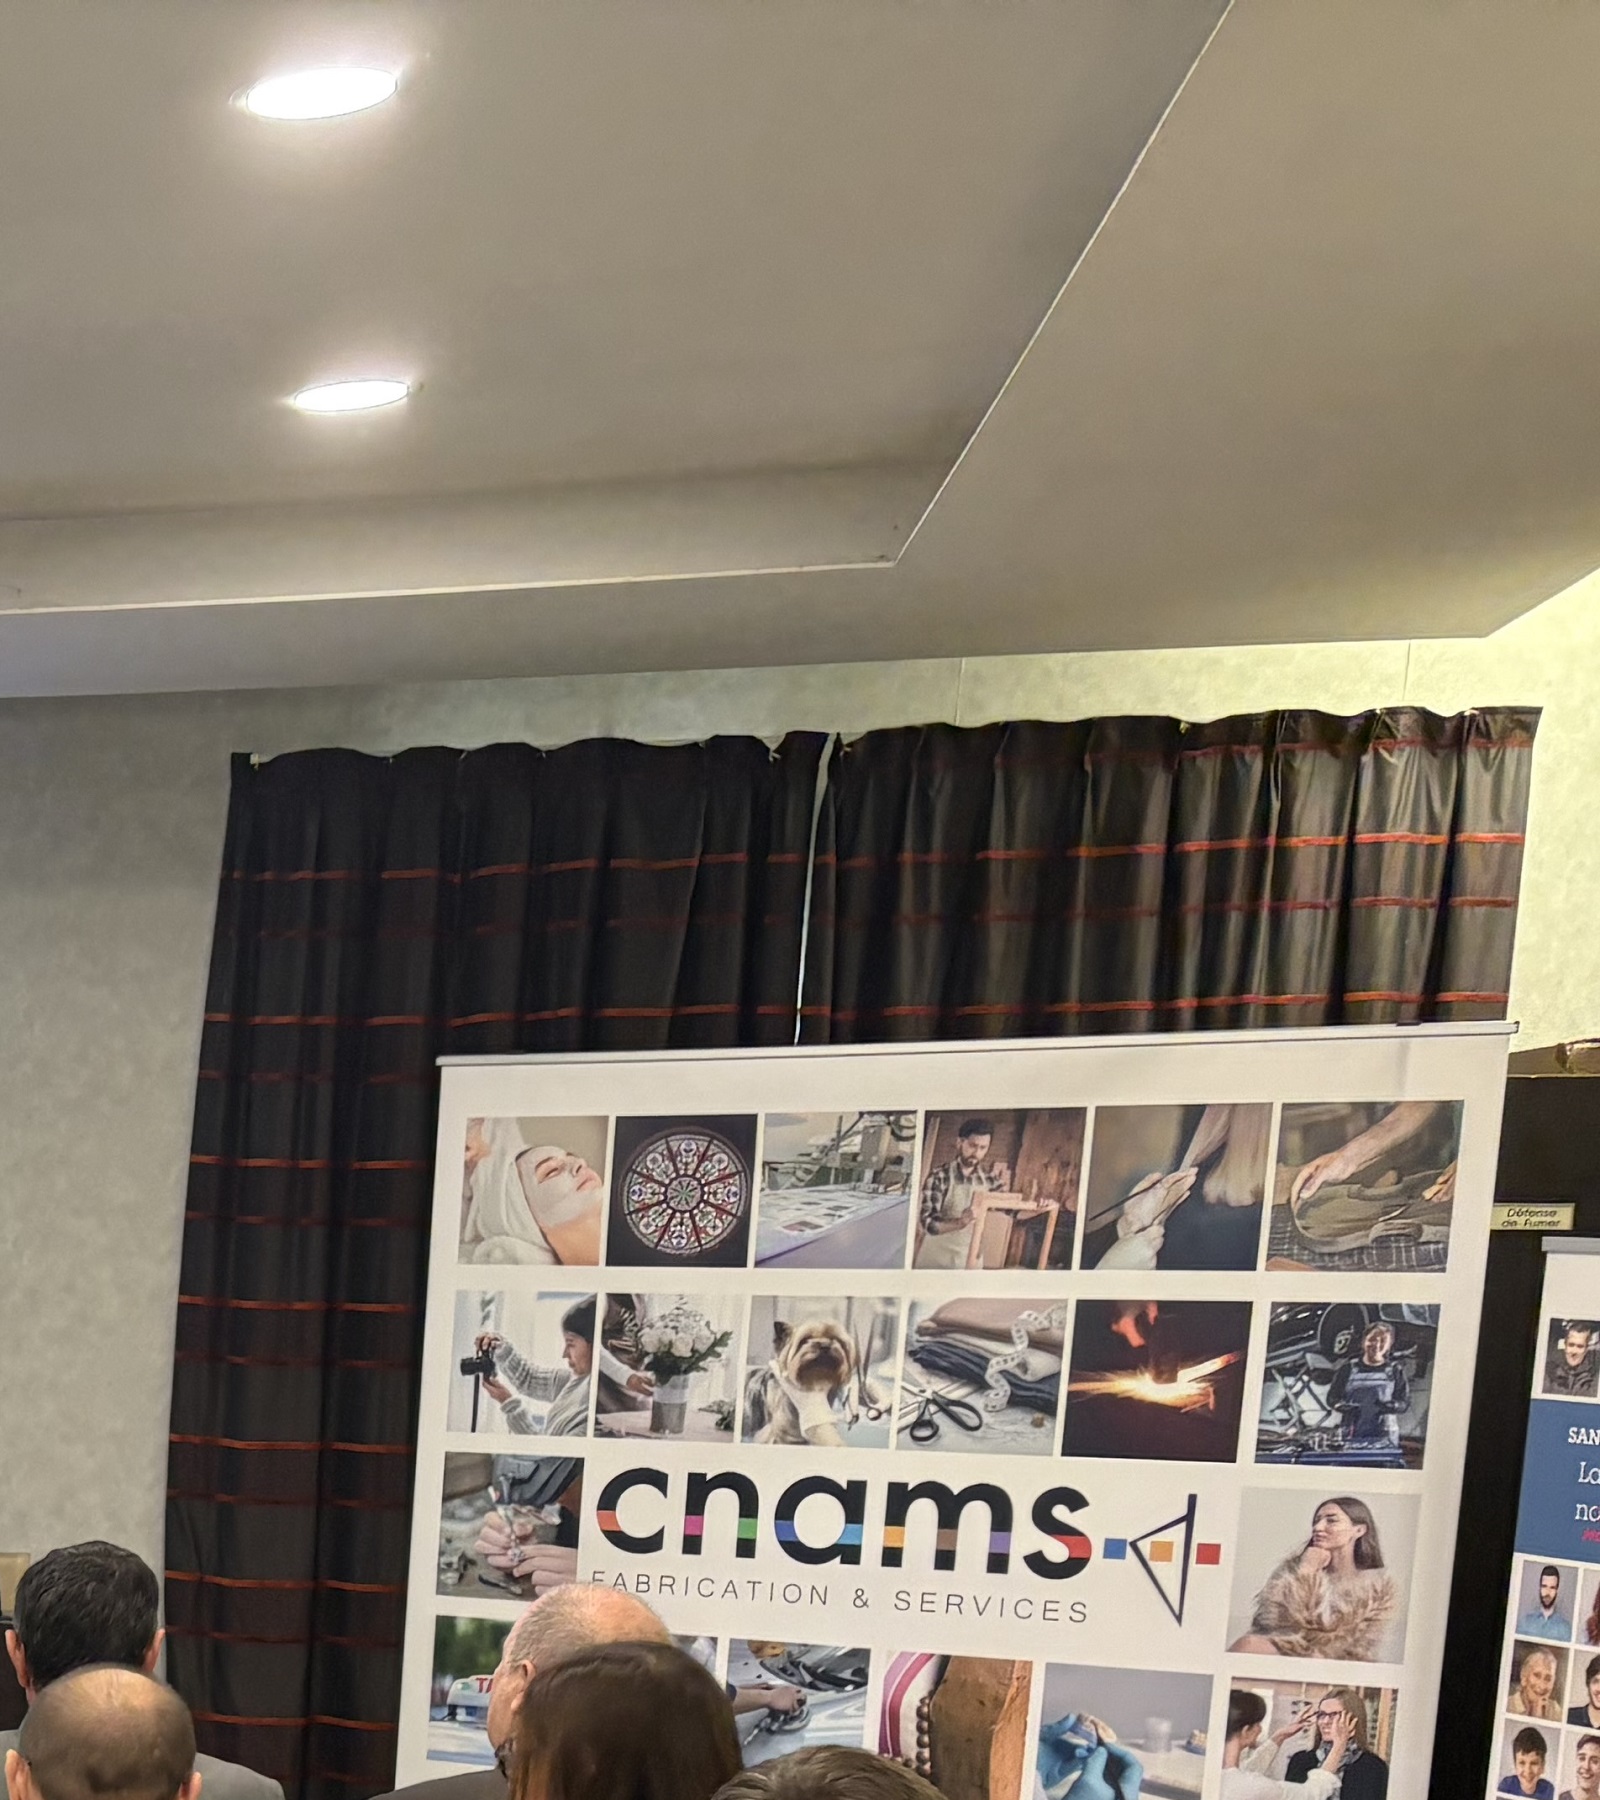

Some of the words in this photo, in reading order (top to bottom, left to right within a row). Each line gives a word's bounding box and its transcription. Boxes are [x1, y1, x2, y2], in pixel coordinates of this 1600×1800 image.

[596, 1466, 1093, 1582] cnams
[590, 1569, 830, 1607] FABRICATION
[853, 1586, 871, 1610] &
[894, 1590, 1090, 1624] SERVICES
